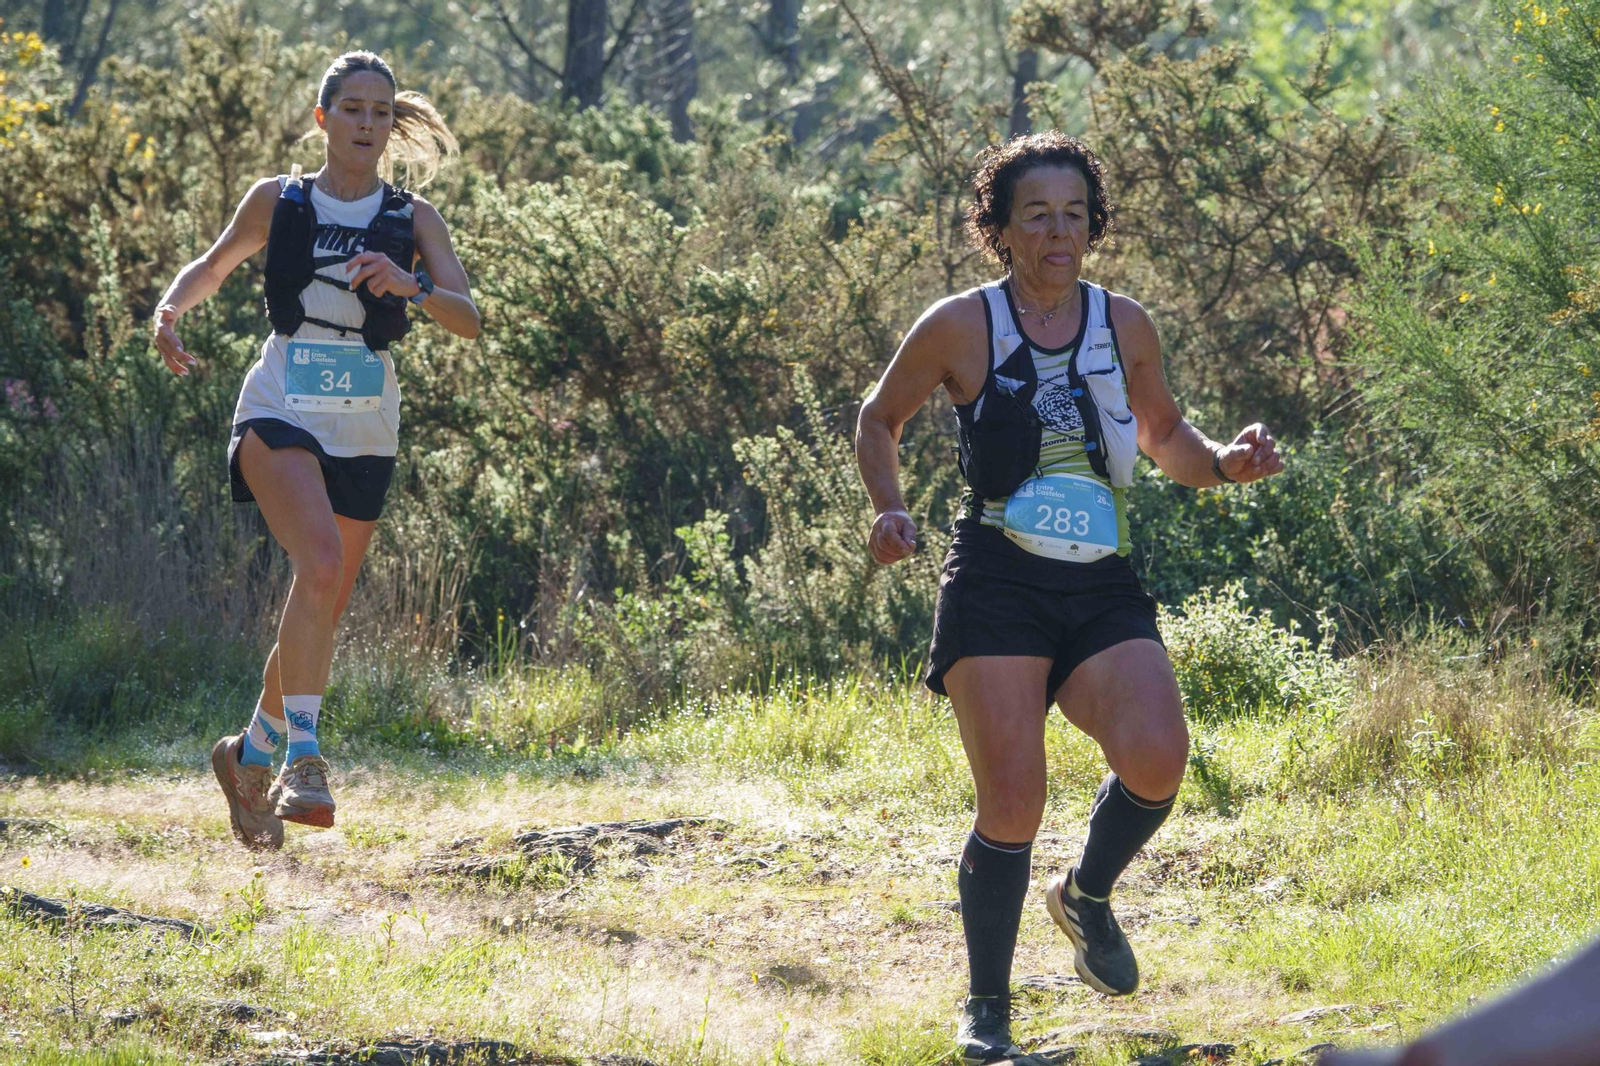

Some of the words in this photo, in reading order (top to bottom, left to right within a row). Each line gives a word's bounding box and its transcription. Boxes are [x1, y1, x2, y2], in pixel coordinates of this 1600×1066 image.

[320, 370, 352, 392] 34
[1036, 490, 1066, 498] Castelos
[1034, 504, 1090, 536] 283
